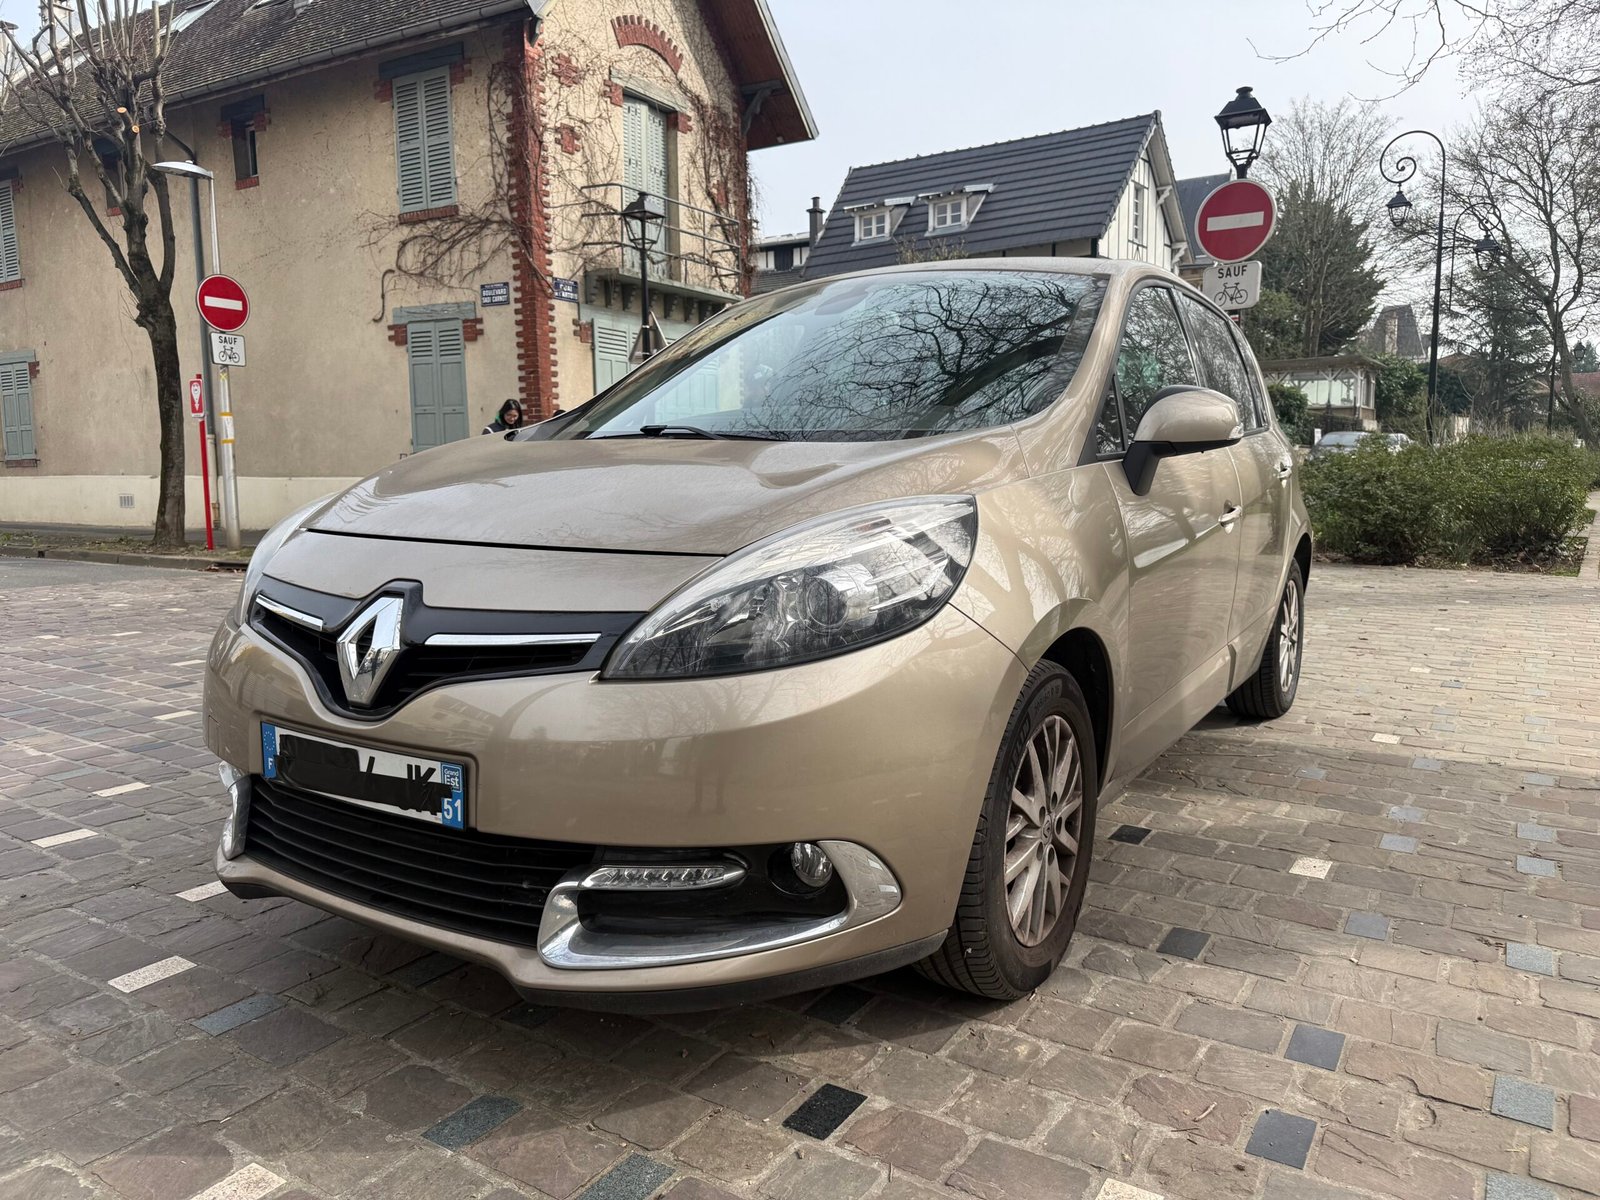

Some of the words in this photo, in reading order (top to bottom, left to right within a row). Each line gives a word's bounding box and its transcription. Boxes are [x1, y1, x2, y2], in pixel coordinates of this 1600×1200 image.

[1218, 265, 1247, 279] SAUF
[482, 288, 507, 296] BOULEVARD
[218, 335, 238, 345] SAUF
[268, 757, 274, 770] F
[444, 768, 459, 777] Grand
[444, 774, 460, 787] Est
[443, 797, 462, 822] 51
